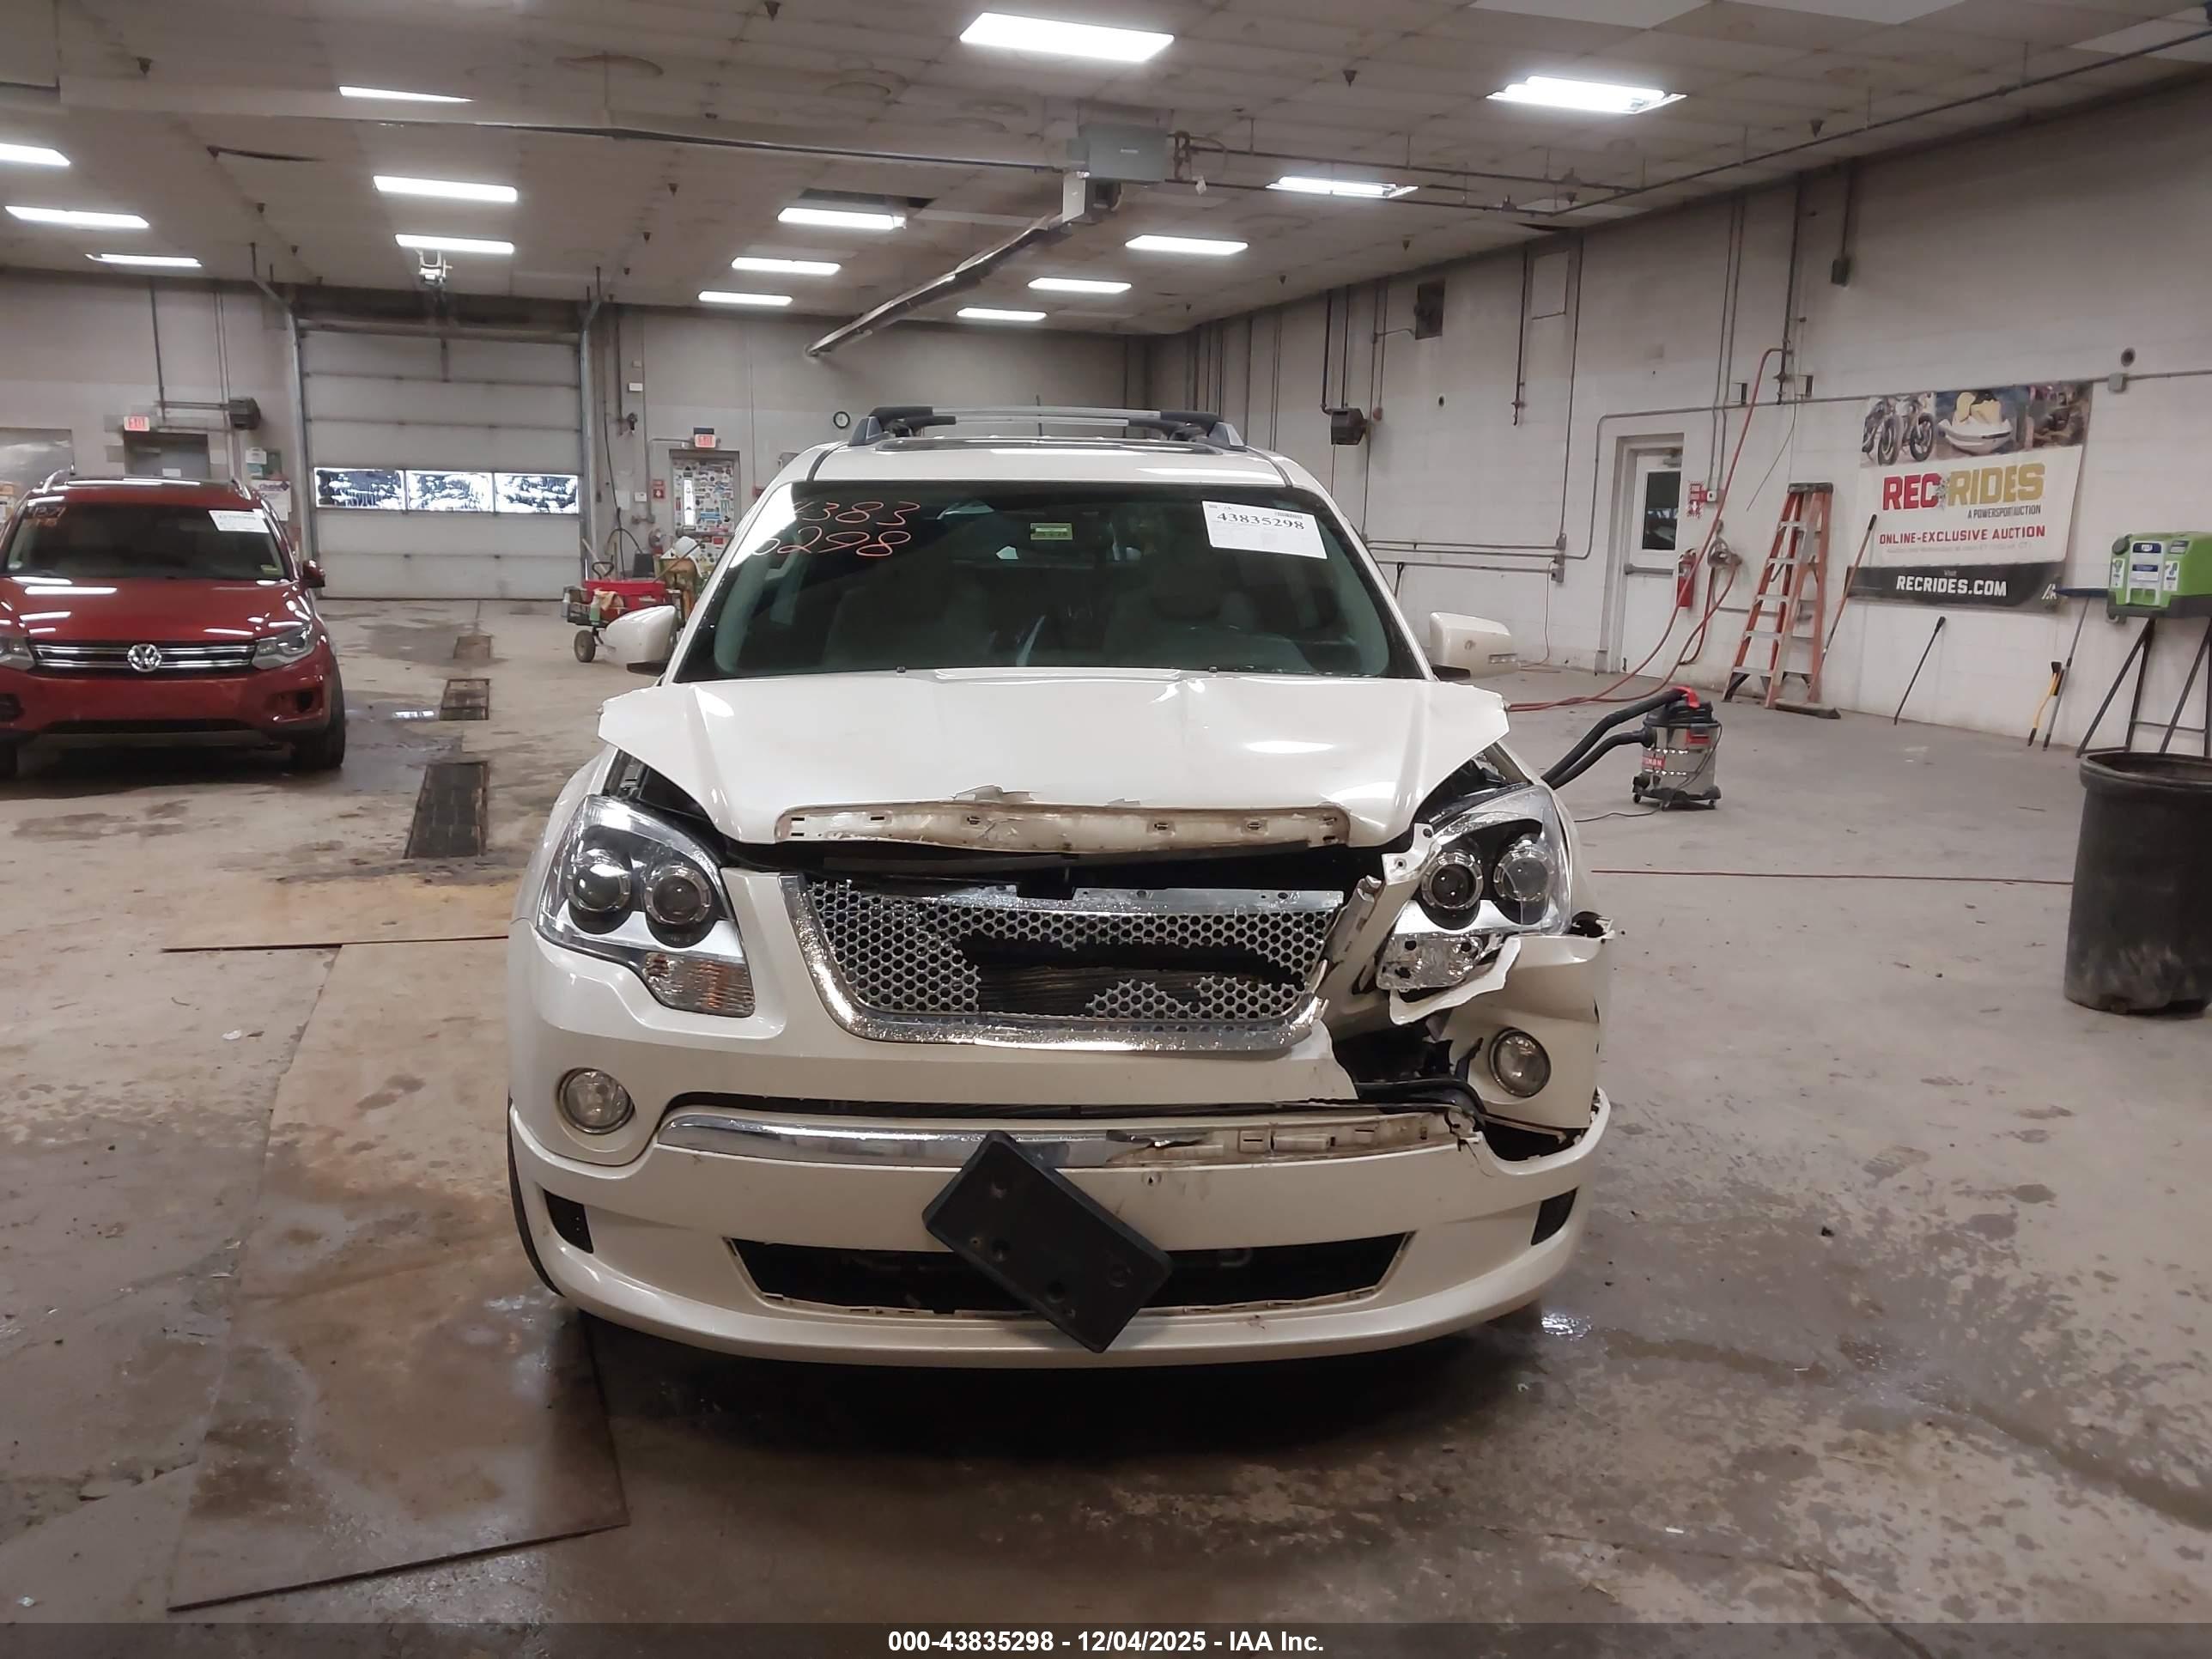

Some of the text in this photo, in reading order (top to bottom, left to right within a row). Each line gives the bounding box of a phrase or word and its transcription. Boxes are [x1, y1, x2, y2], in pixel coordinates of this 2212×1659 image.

[1882, 463, 2045, 510] REC RIDES
[1217, 512, 1305, 530] 43835298
[1967, 509, 1972, 519] A
[1879, 525, 2045, 544] ONLINE-EXCLUSIVE AUCTION
[1896, 575, 2007, 596] RECRIDES.COM
